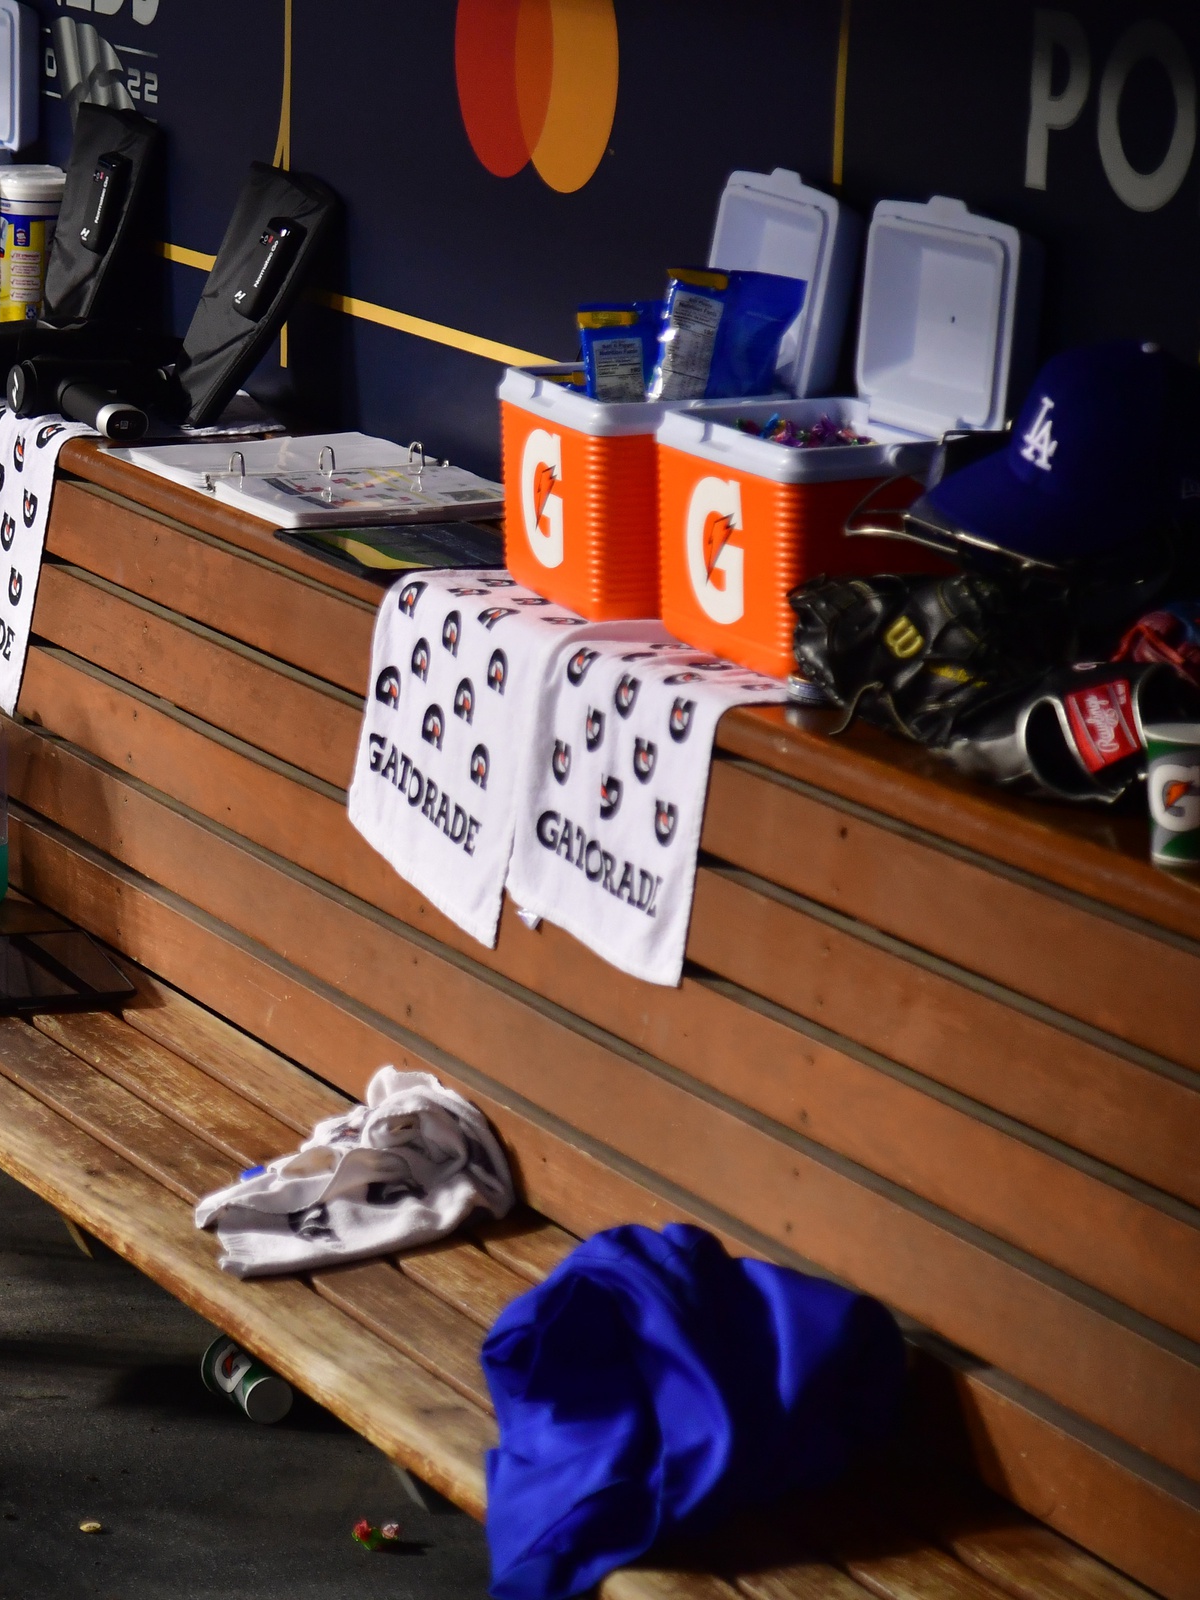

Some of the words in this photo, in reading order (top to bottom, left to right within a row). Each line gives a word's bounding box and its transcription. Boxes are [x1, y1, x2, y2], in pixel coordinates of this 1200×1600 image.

[1024, 8, 1198, 213] PO
[253, 251, 274, 288] Normatec
[270, 239, 279, 252] Go
[1020, 397, 1058, 471] LA
[522, 428, 564, 569] G
[687, 476, 745, 625] G
[368, 732, 483, 858] GATORADE
[1149, 763, 1200, 832] G
